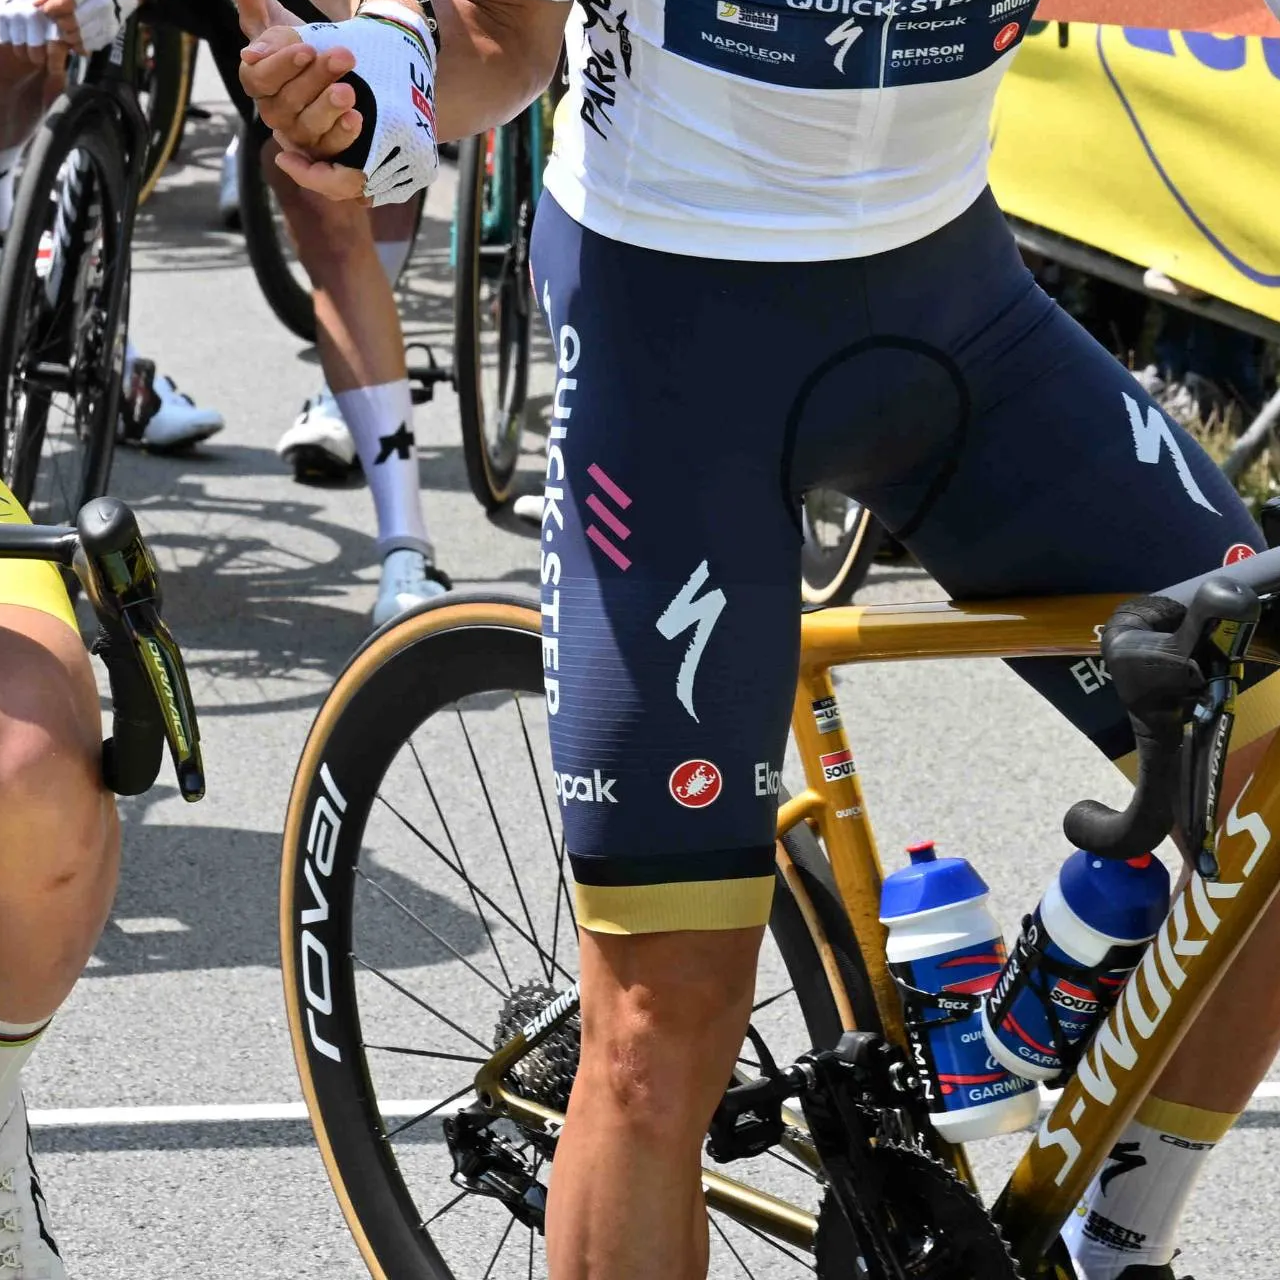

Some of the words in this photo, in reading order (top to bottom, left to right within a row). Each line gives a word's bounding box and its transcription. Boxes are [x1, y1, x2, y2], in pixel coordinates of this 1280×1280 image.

[895, 15, 967, 32] Ekopak
[701, 31, 796, 63] NAPOLEON
[891, 43, 966, 60] RENSON
[890, 54, 965, 69] OUTDOOR
[937, 998, 970, 1011] Tacx
